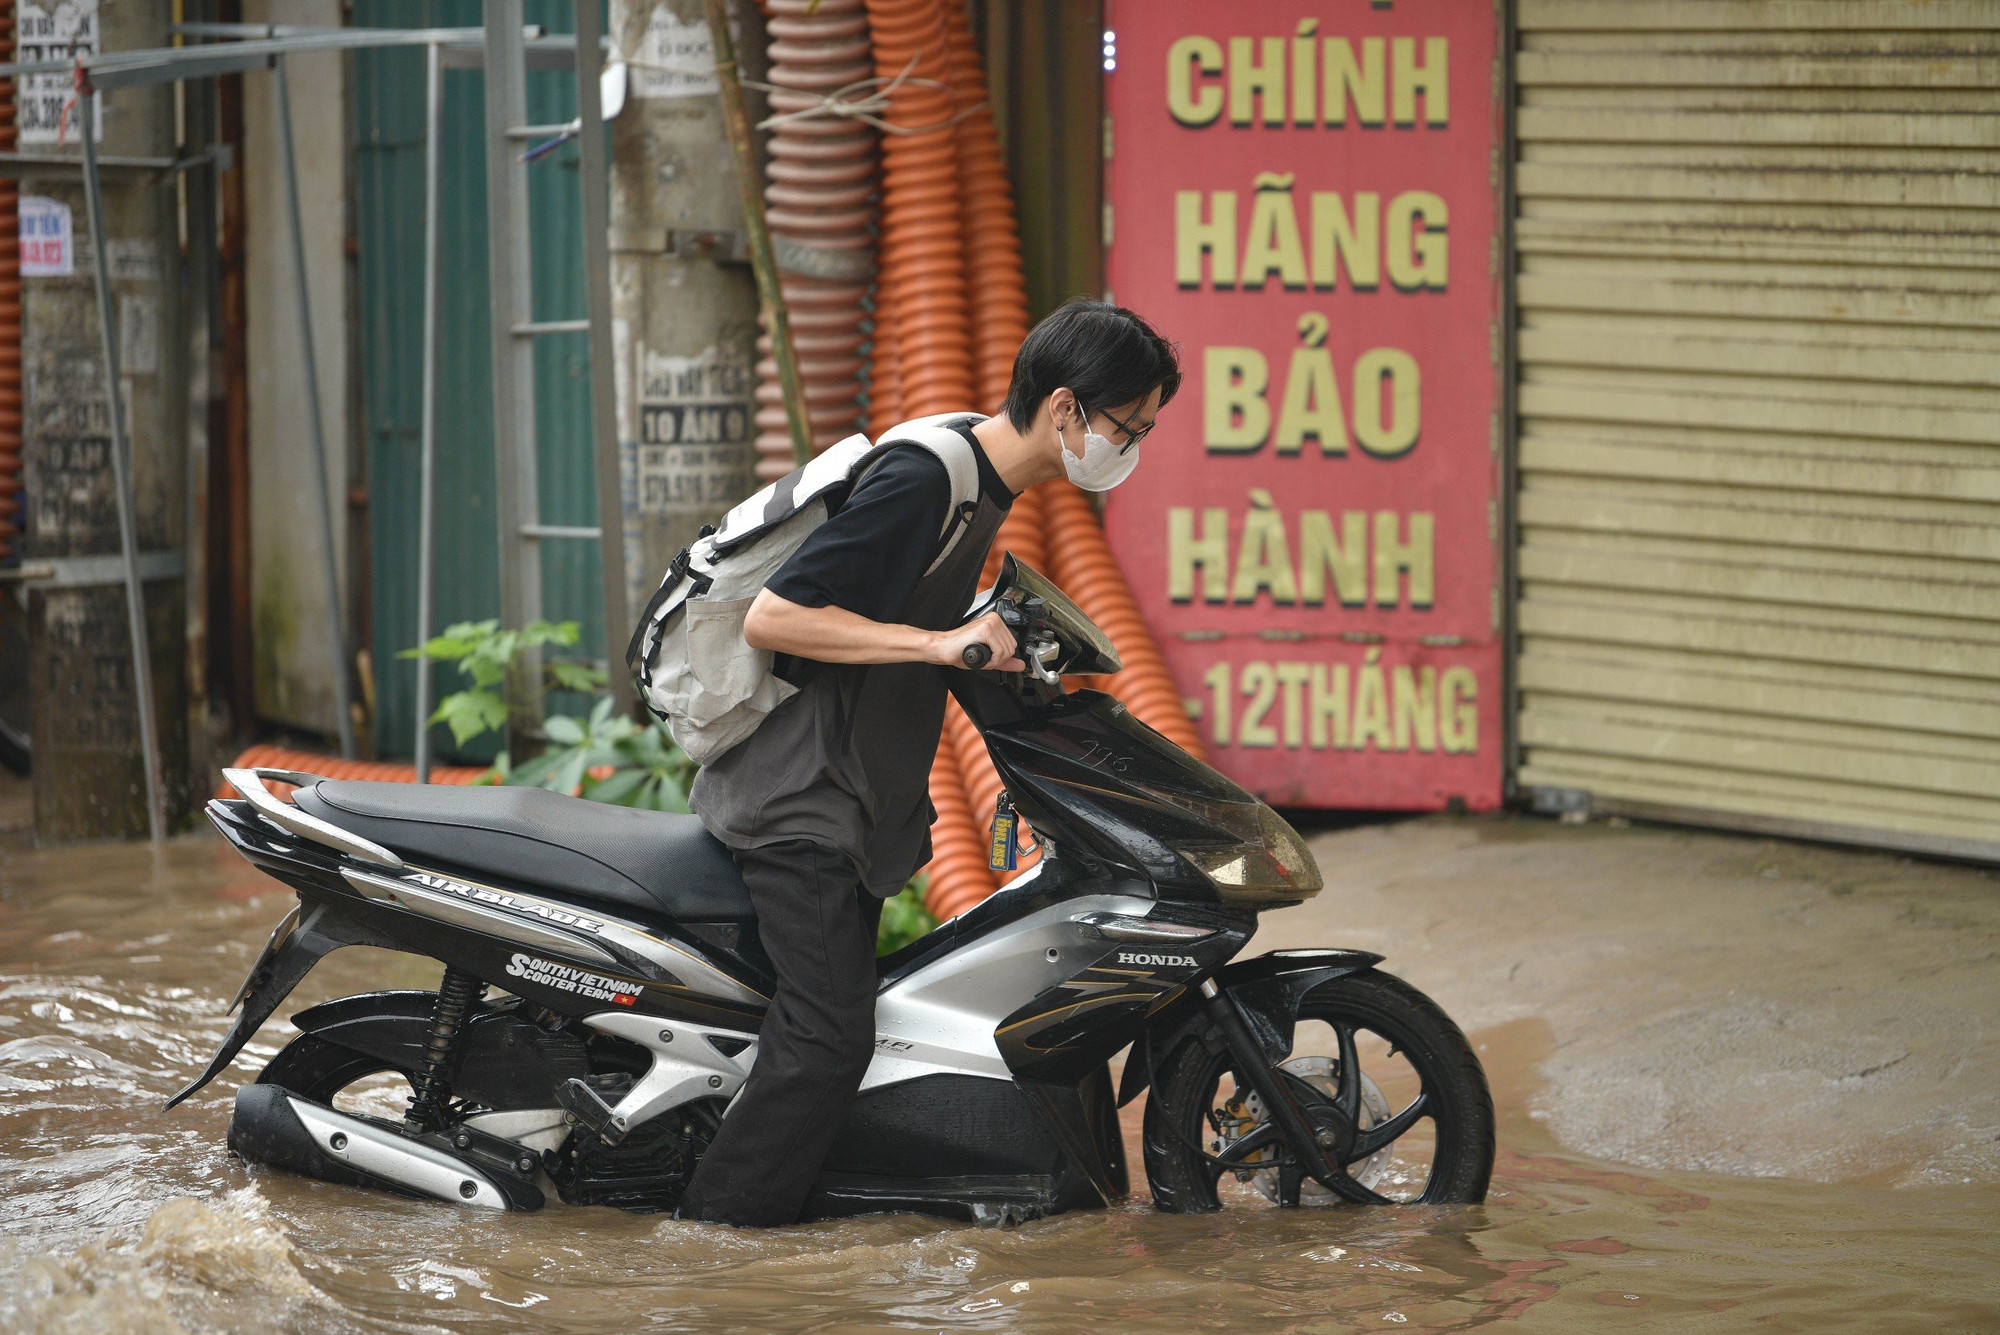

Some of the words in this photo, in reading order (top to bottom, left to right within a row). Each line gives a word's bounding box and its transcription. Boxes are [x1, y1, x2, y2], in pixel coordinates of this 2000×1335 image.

[1166, 17, 1449, 129] CHÍNH
[1175, 171, 1450, 293] HÃNG
[1203, 311, 1422, 459] BẢO
[1167, 488, 1435, 609] HÀNH
[1118, 952, 1199, 967] HONDA
